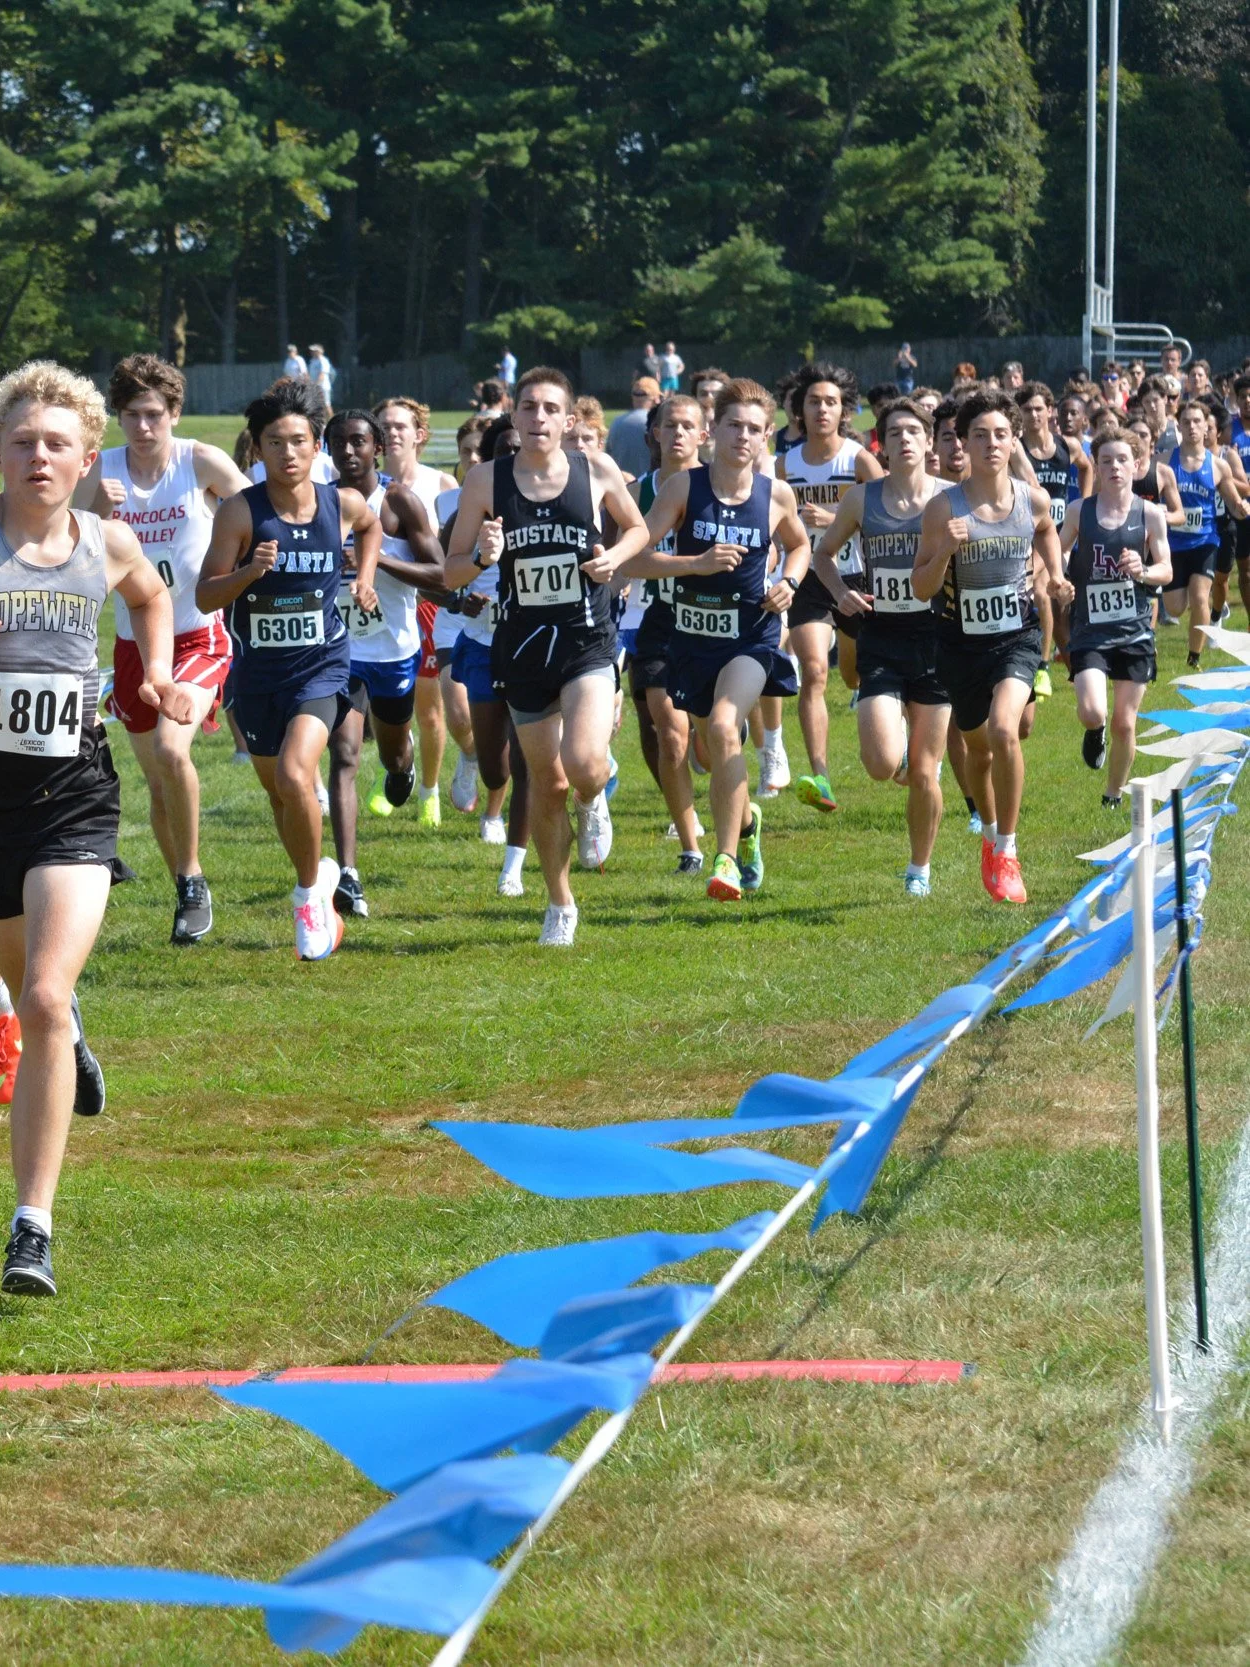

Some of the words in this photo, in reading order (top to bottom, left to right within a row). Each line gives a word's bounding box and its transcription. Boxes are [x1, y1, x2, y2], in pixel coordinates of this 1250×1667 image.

[797, 485, 839, 505] MCNAIR
[112, 504, 186, 525] RANCOCAS
[506, 523, 587, 550] EUSTACE
[693, 520, 761, 547] SPARTA
[869, 533, 922, 559] HOPEW
[272, 551, 334, 573] PARTA
[960, 536, 1029, 564] HOPEWELL
[516, 562, 576, 594] 1707
[875, 576, 914, 602] 181
[963, 593, 1018, 623] 1805
[1089, 588, 1135, 613] 1835
[257, 616, 316, 642] 6305
[340, 604, 383, 630] 734
[681, 608, 732, 633] 6303
